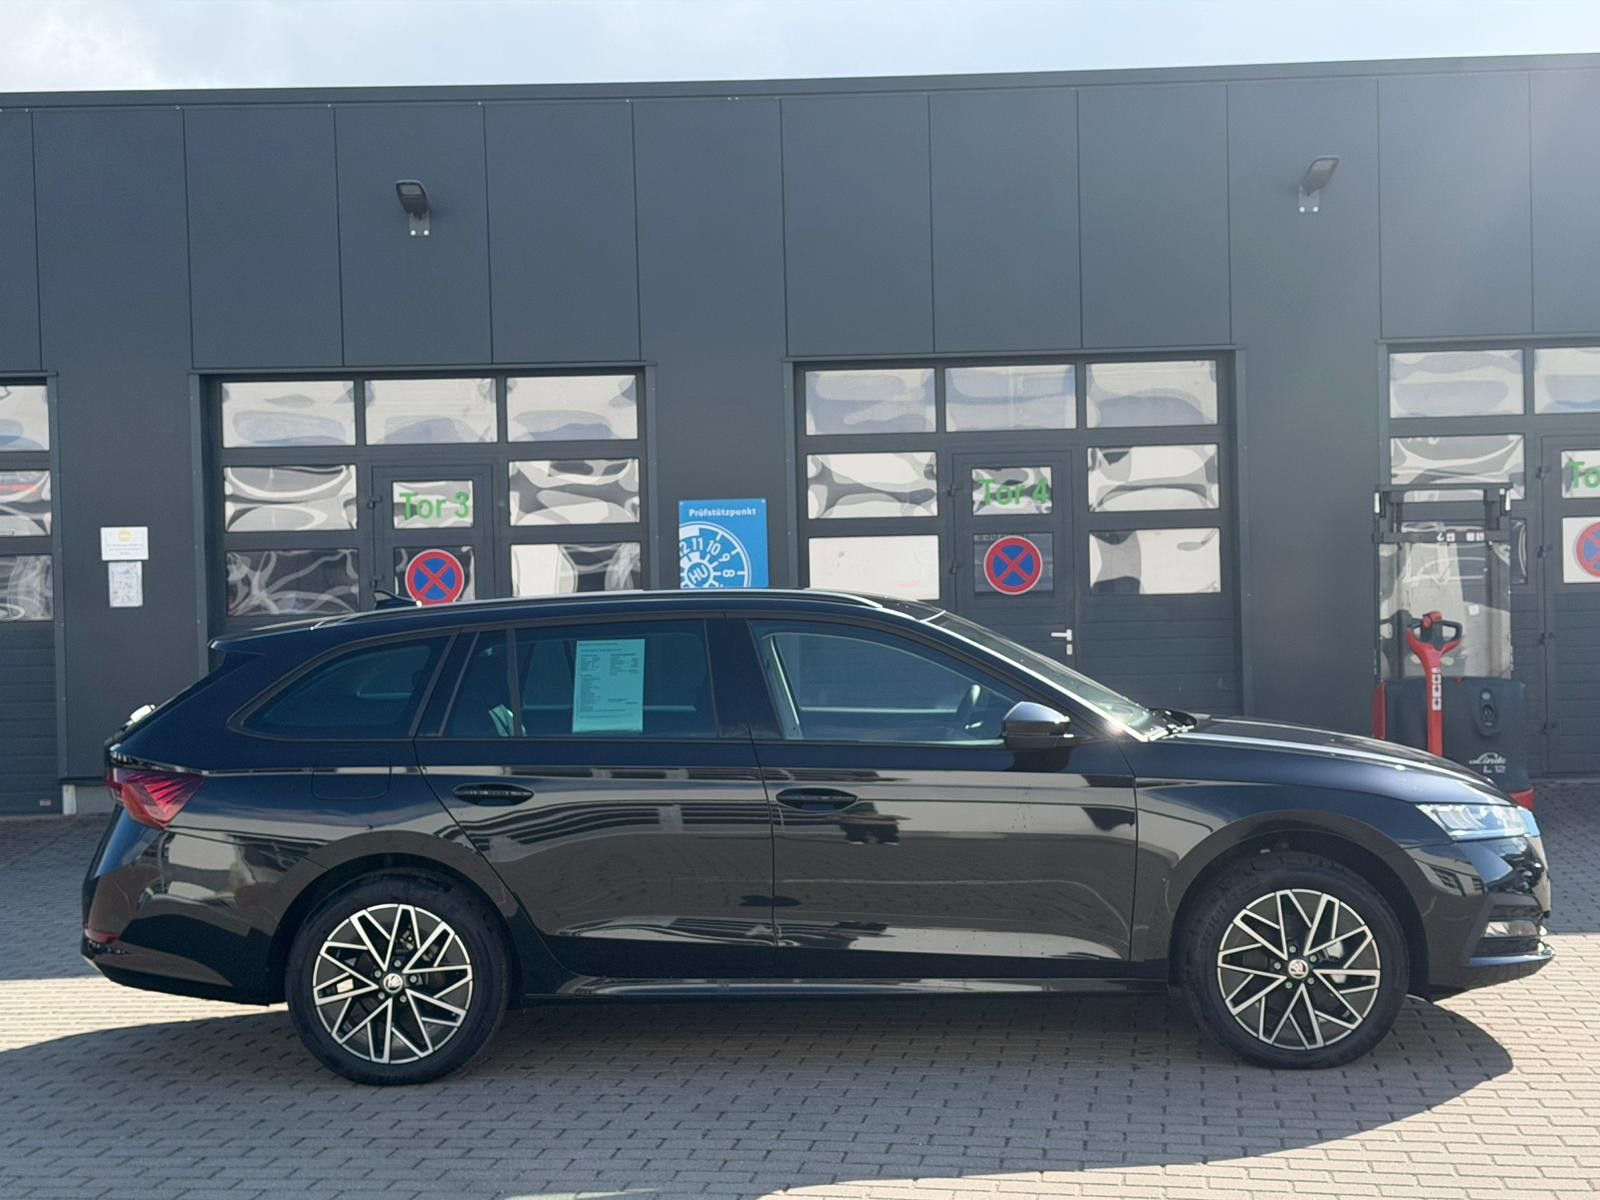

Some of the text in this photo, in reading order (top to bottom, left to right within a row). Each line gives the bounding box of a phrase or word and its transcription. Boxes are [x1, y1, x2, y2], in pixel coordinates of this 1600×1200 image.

[978, 477, 1050, 506] Tor 4
[399, 491, 469, 520] Tor 3
[688, 507, 757, 517] Prüfstützpunkt
[691, 537, 704, 551] 11
[706, 540, 721, 556] 10
[718, 552, 731, 562] 9
[688, 564, 709, 584] HU
[722, 569, 735, 578] 8
